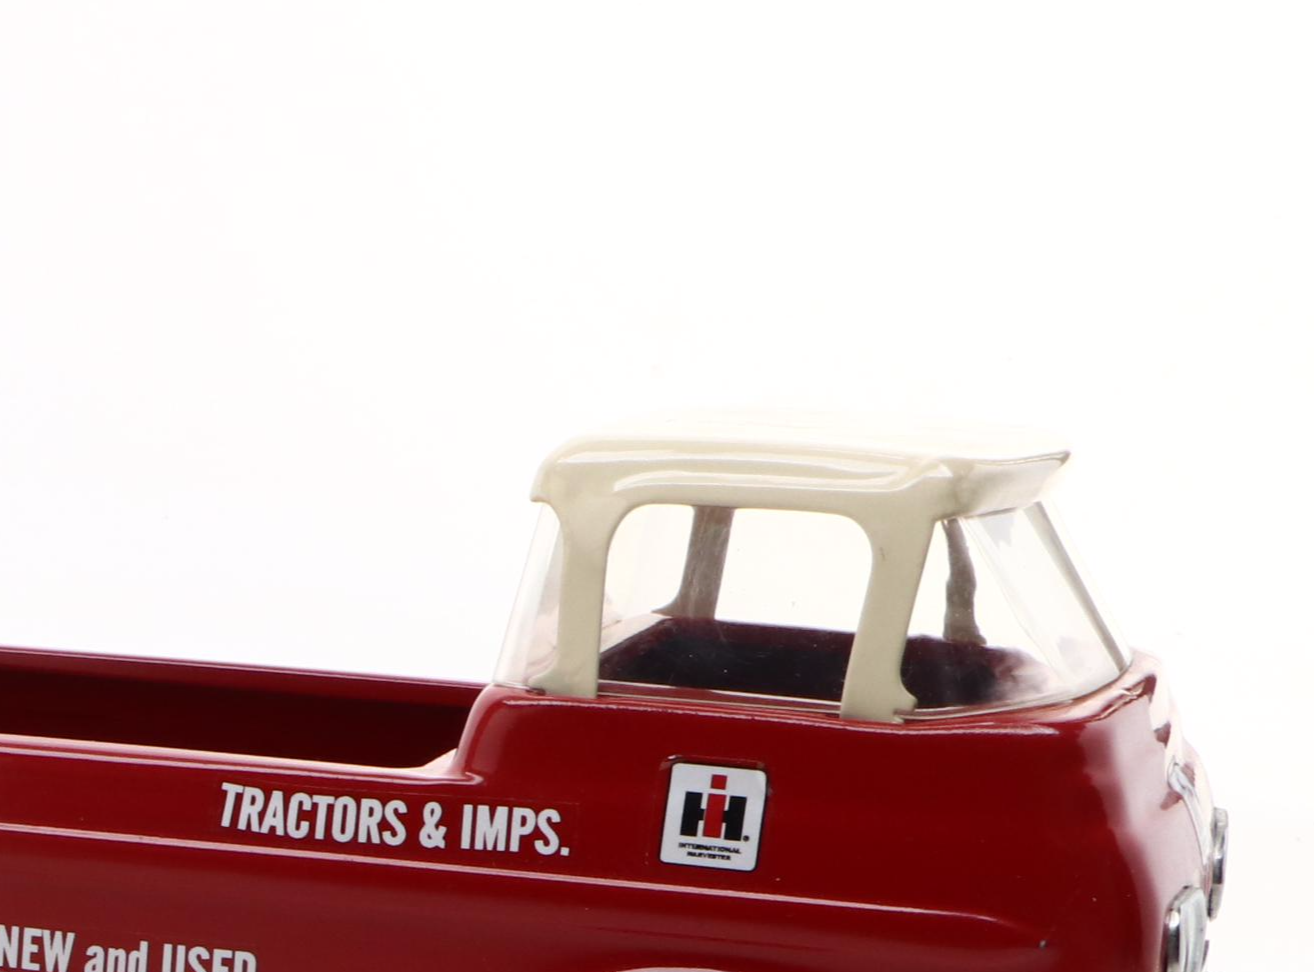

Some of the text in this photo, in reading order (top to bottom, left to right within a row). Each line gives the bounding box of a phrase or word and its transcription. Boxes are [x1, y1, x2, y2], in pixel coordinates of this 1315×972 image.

[220, 782, 570, 857] TRACTORS & IMPS.
